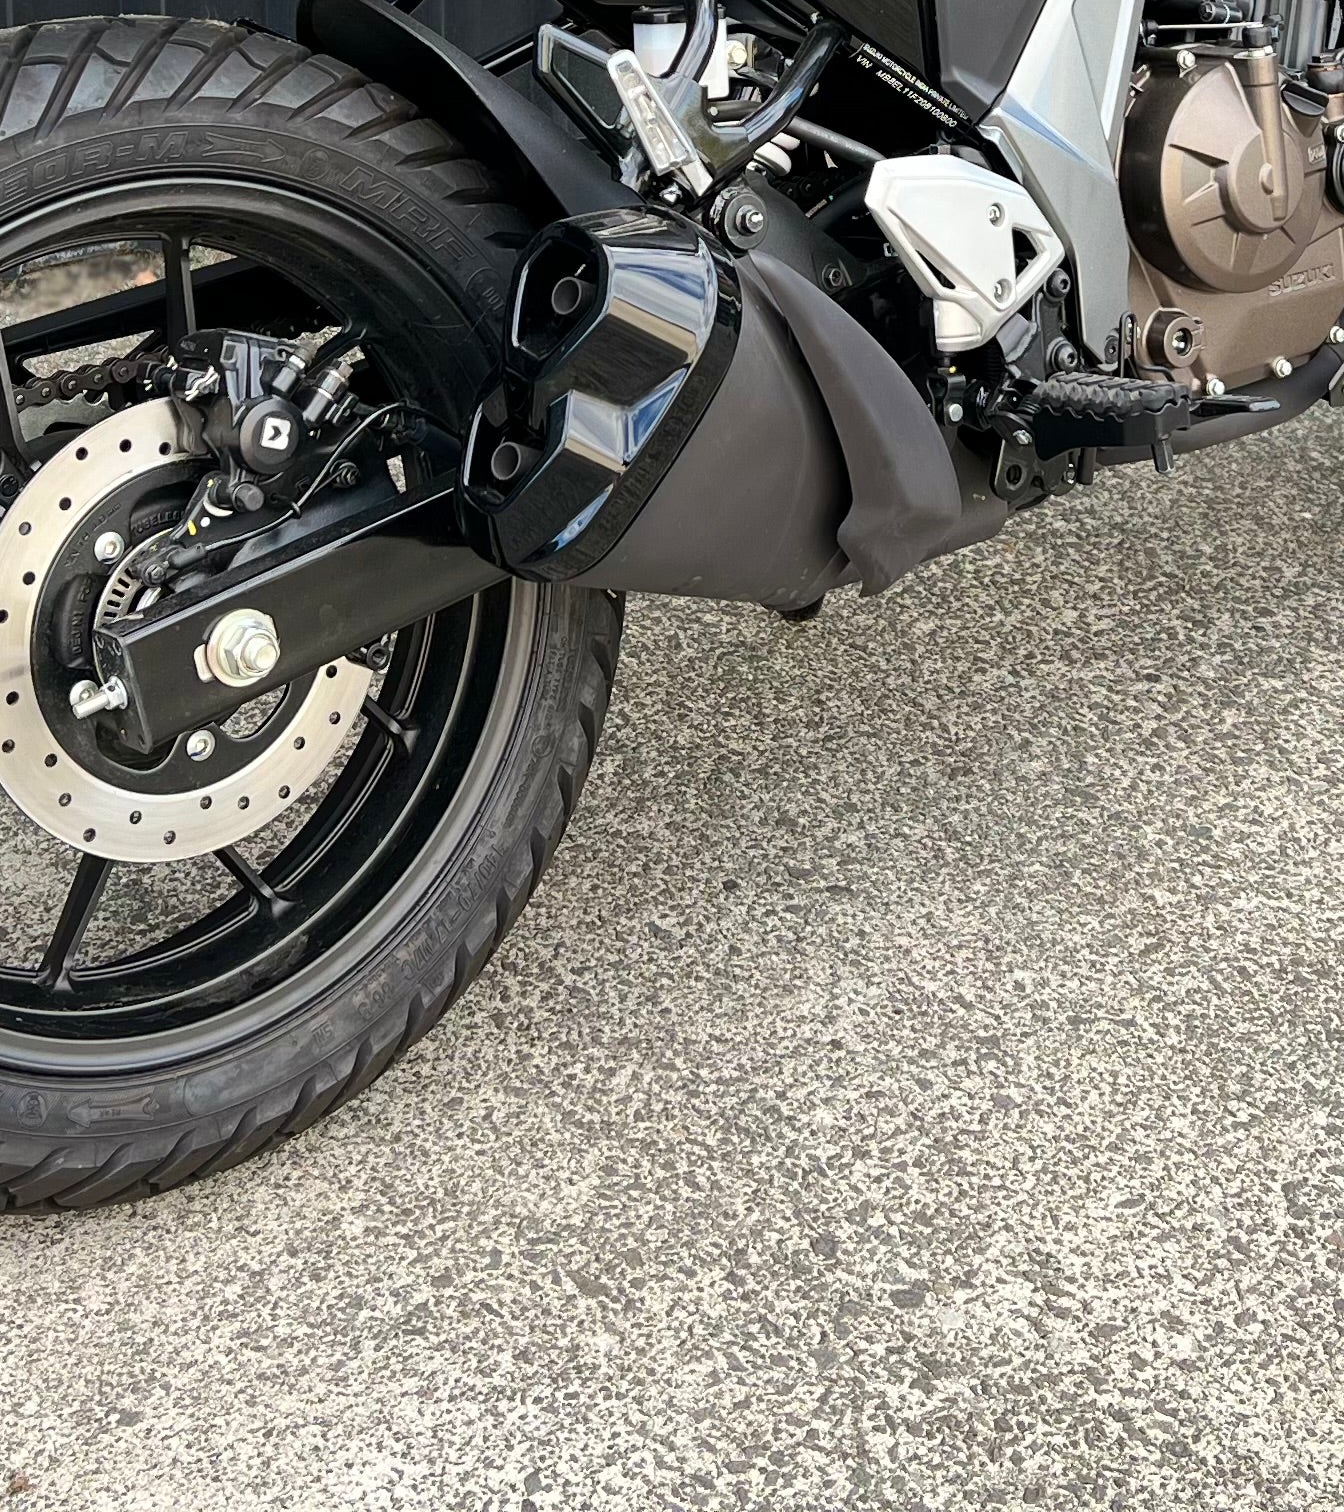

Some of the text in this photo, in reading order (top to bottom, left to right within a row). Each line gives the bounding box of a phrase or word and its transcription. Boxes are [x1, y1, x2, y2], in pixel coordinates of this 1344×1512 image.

[856, 54, 873, 69] VIN
[882, 56, 916, 84] MOTORCYCLE
[339, 166, 475, 262] MRF
[1267, 262, 1337, 298] SUZUKI
